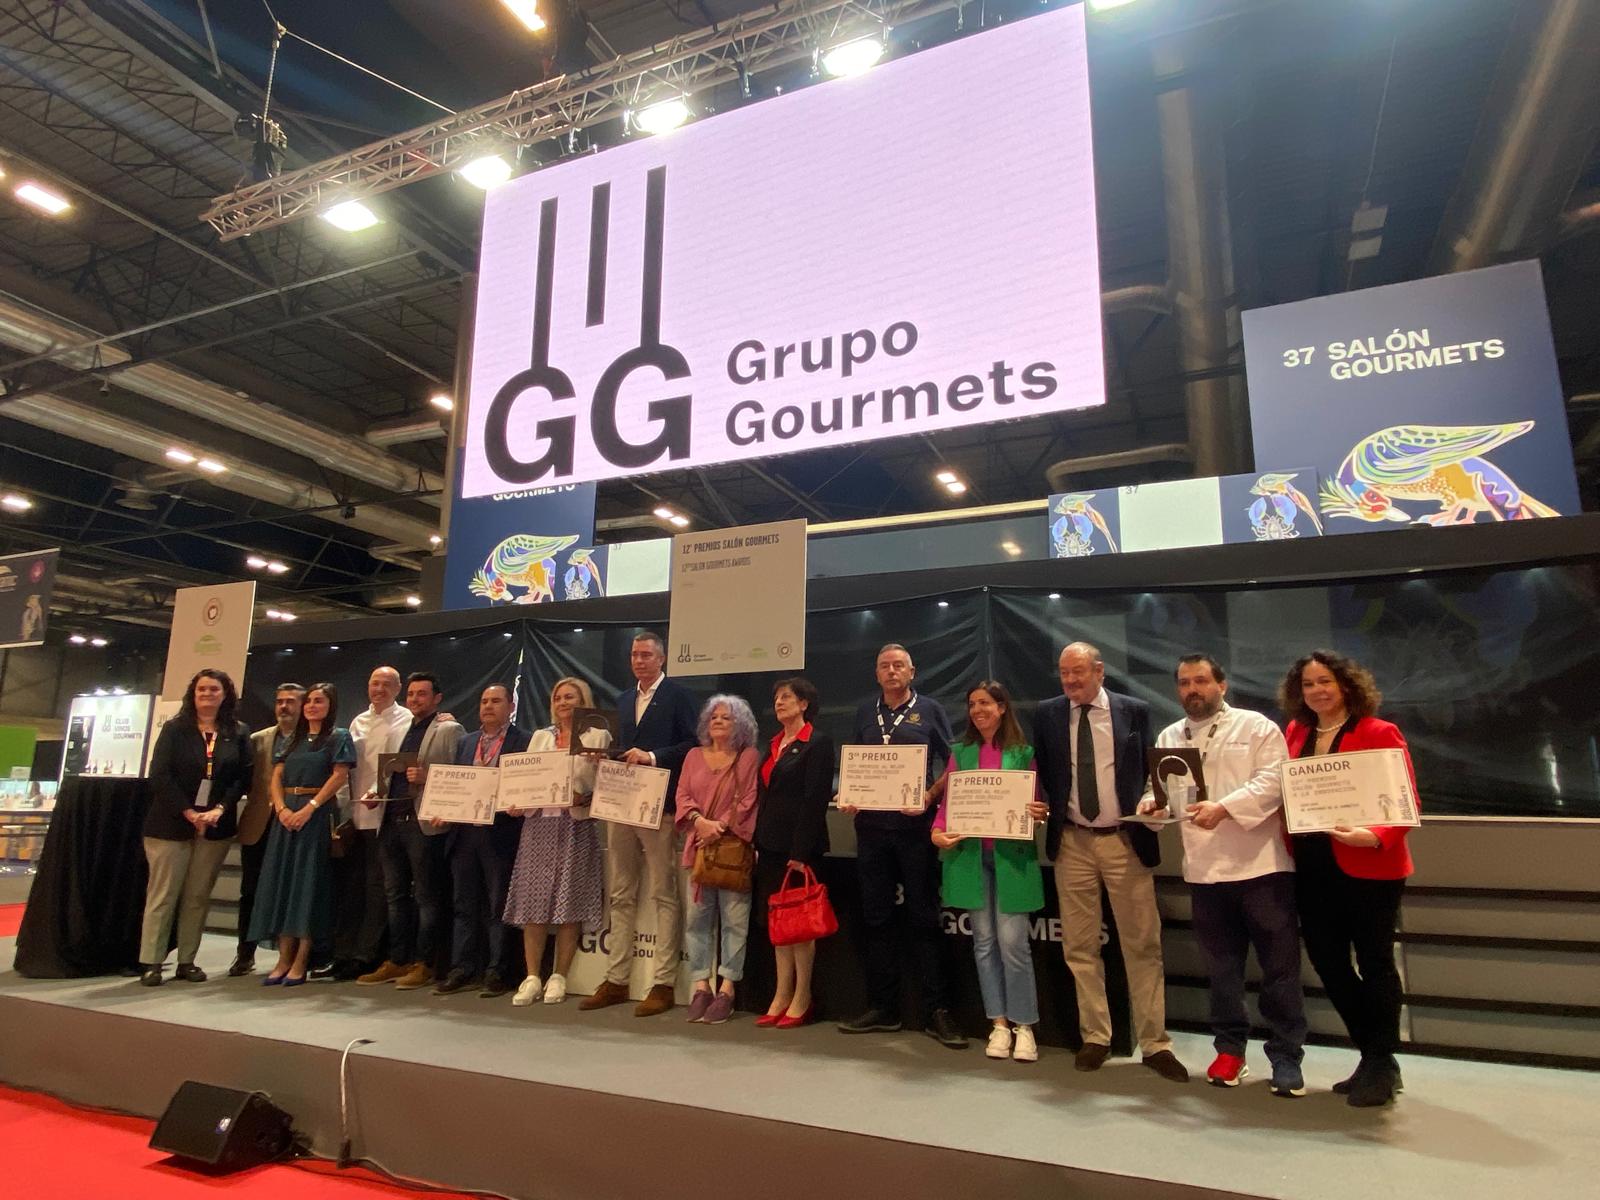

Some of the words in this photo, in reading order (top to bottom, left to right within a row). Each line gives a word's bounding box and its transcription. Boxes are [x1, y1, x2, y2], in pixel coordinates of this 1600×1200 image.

[726, 320, 919, 386] Grupo
[1283, 346, 1316, 368] 37
[1328, 328, 1431, 361] SALÓN
[1330, 339, 1506, 381] GOURMETS
[725, 359, 1059, 446] Gourmets
[693, 541, 721, 554] PREMIOS
[744, 533, 780, 548] GOURMETS
[504, 757, 542, 768] GANADOR
[861, 752, 899, 761] PREMIO
[444, 770, 477, 780] PREMIO
[1289, 760, 1351, 777] GANADOR
[964, 776, 1002, 786] PREMIO
